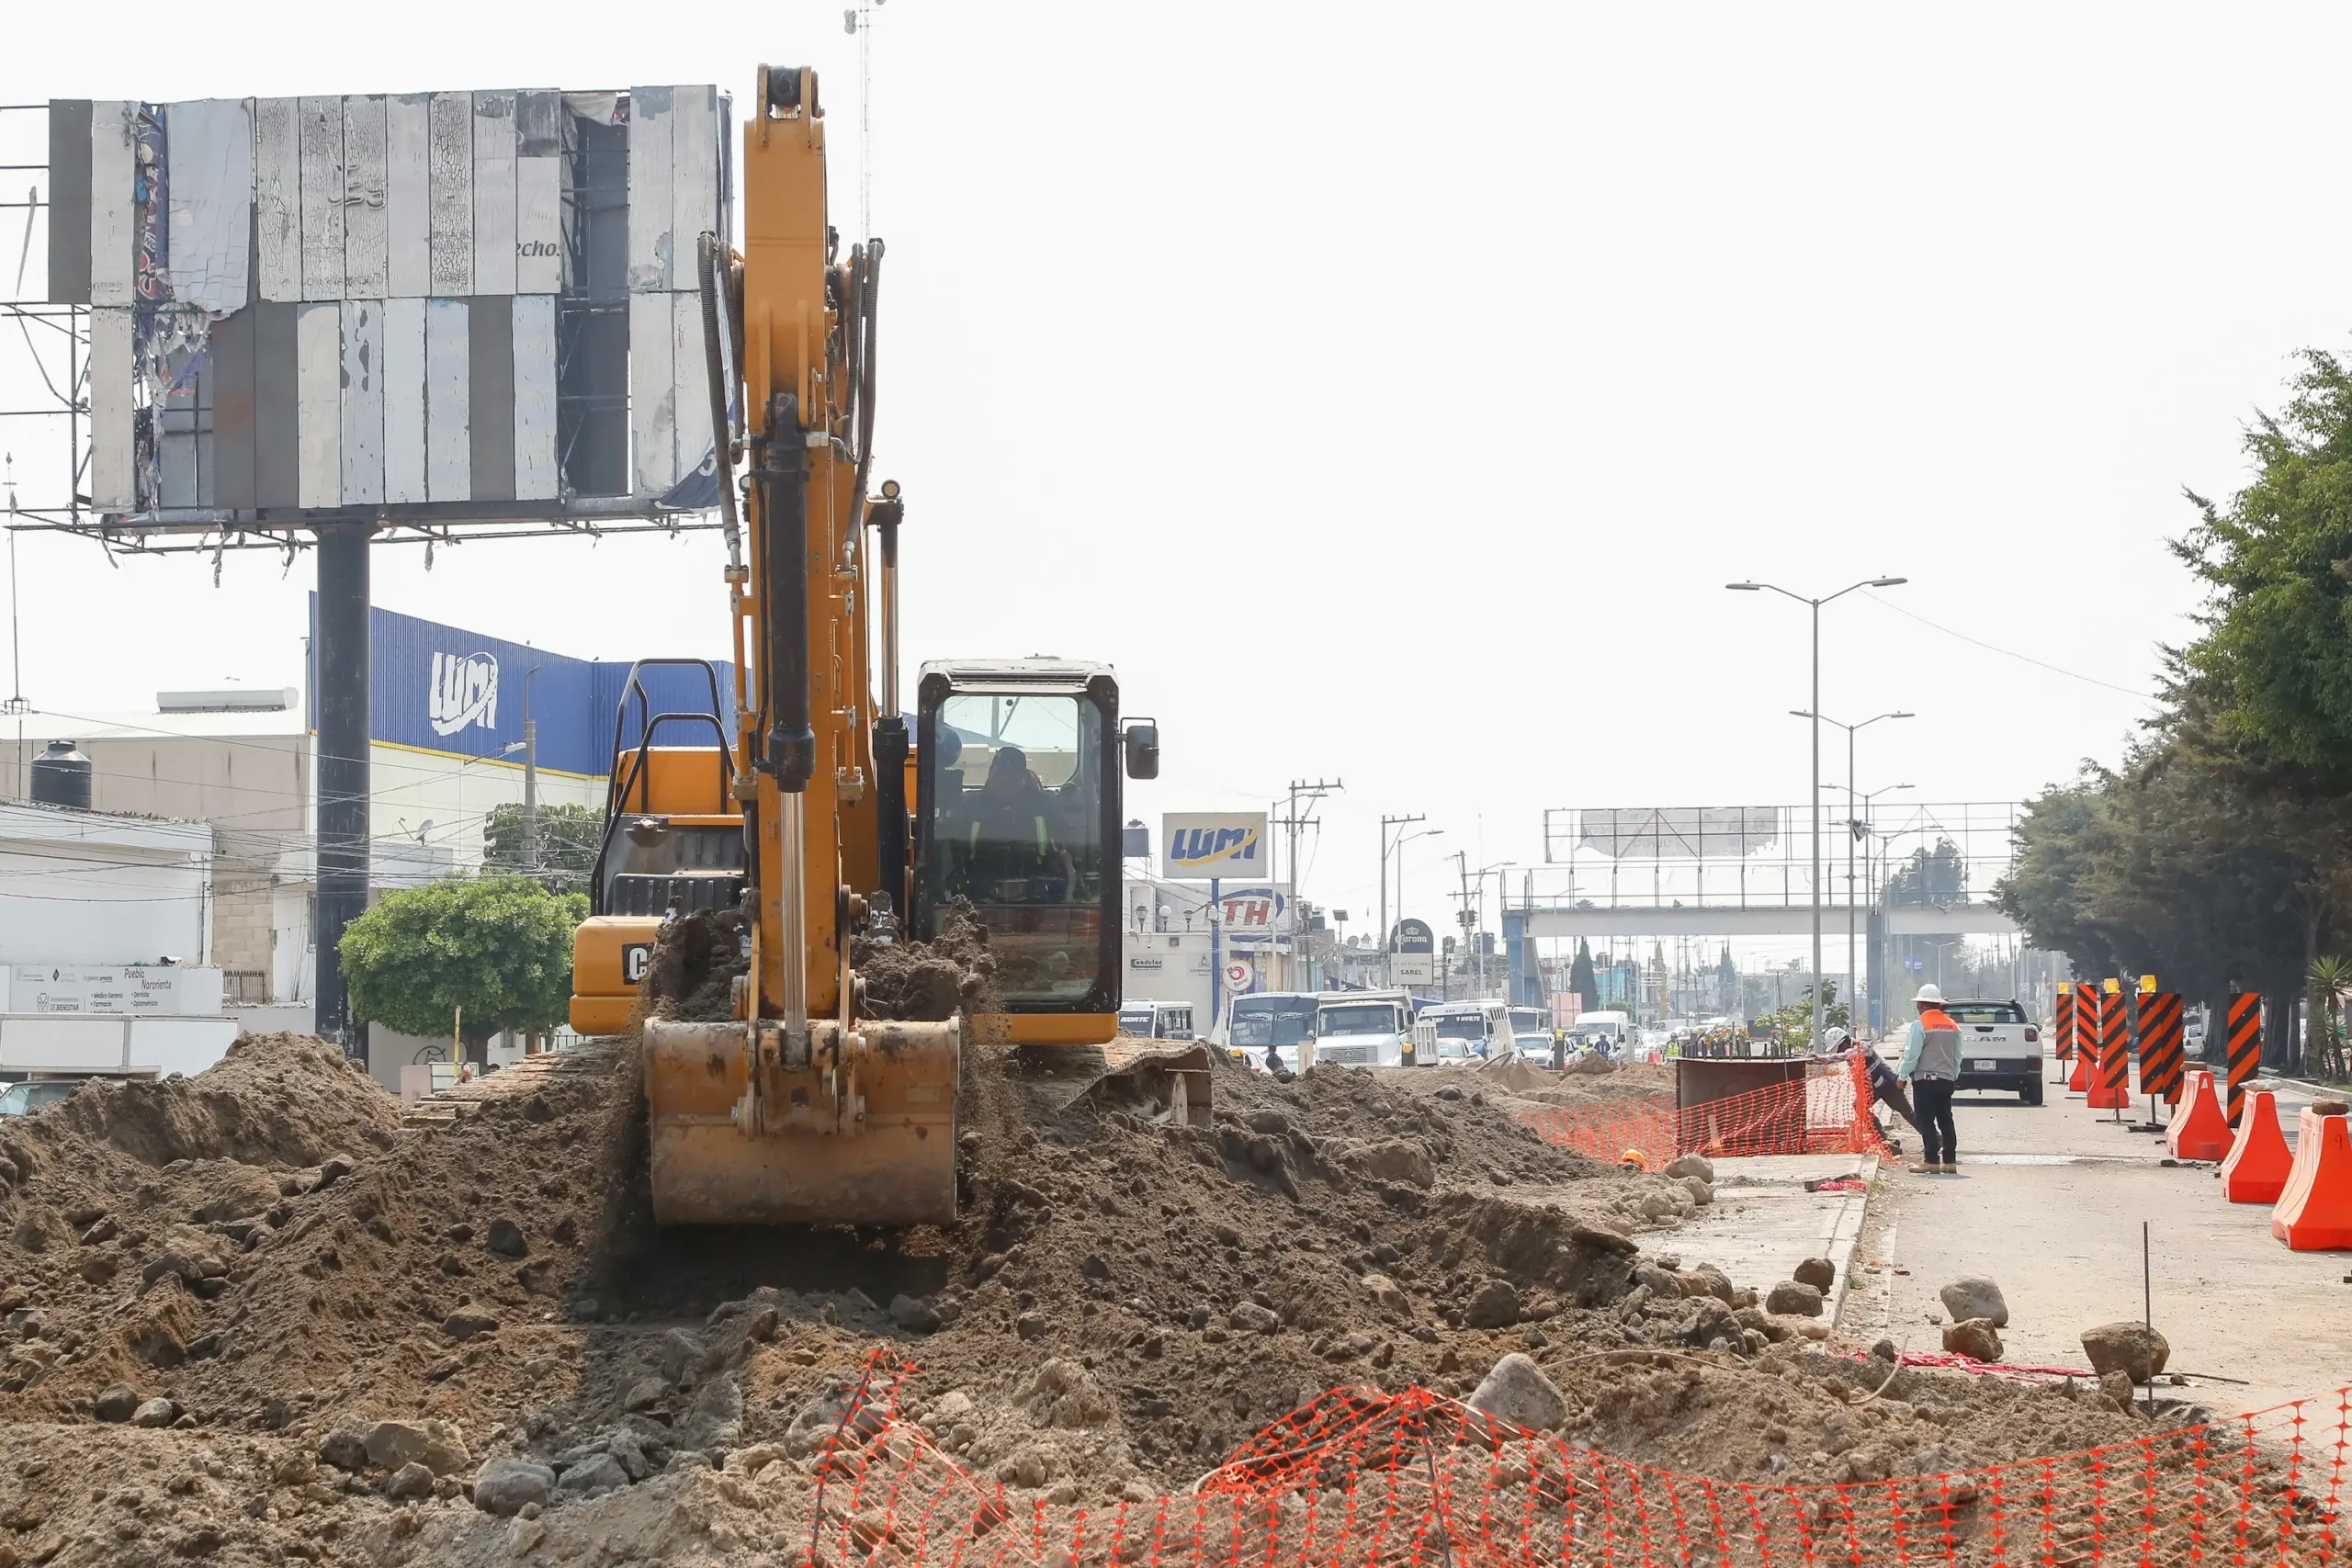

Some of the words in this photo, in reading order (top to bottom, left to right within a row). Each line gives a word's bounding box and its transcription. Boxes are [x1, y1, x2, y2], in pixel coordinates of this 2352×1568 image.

[1170, 827, 1258, 861] LUMI
[1394, 933, 1428, 945] Corona
[124, 968, 145, 978] Puebla
[141, 979, 173, 990] Nororiente
[56, 1003, 80, 1011] BIENESTAR
